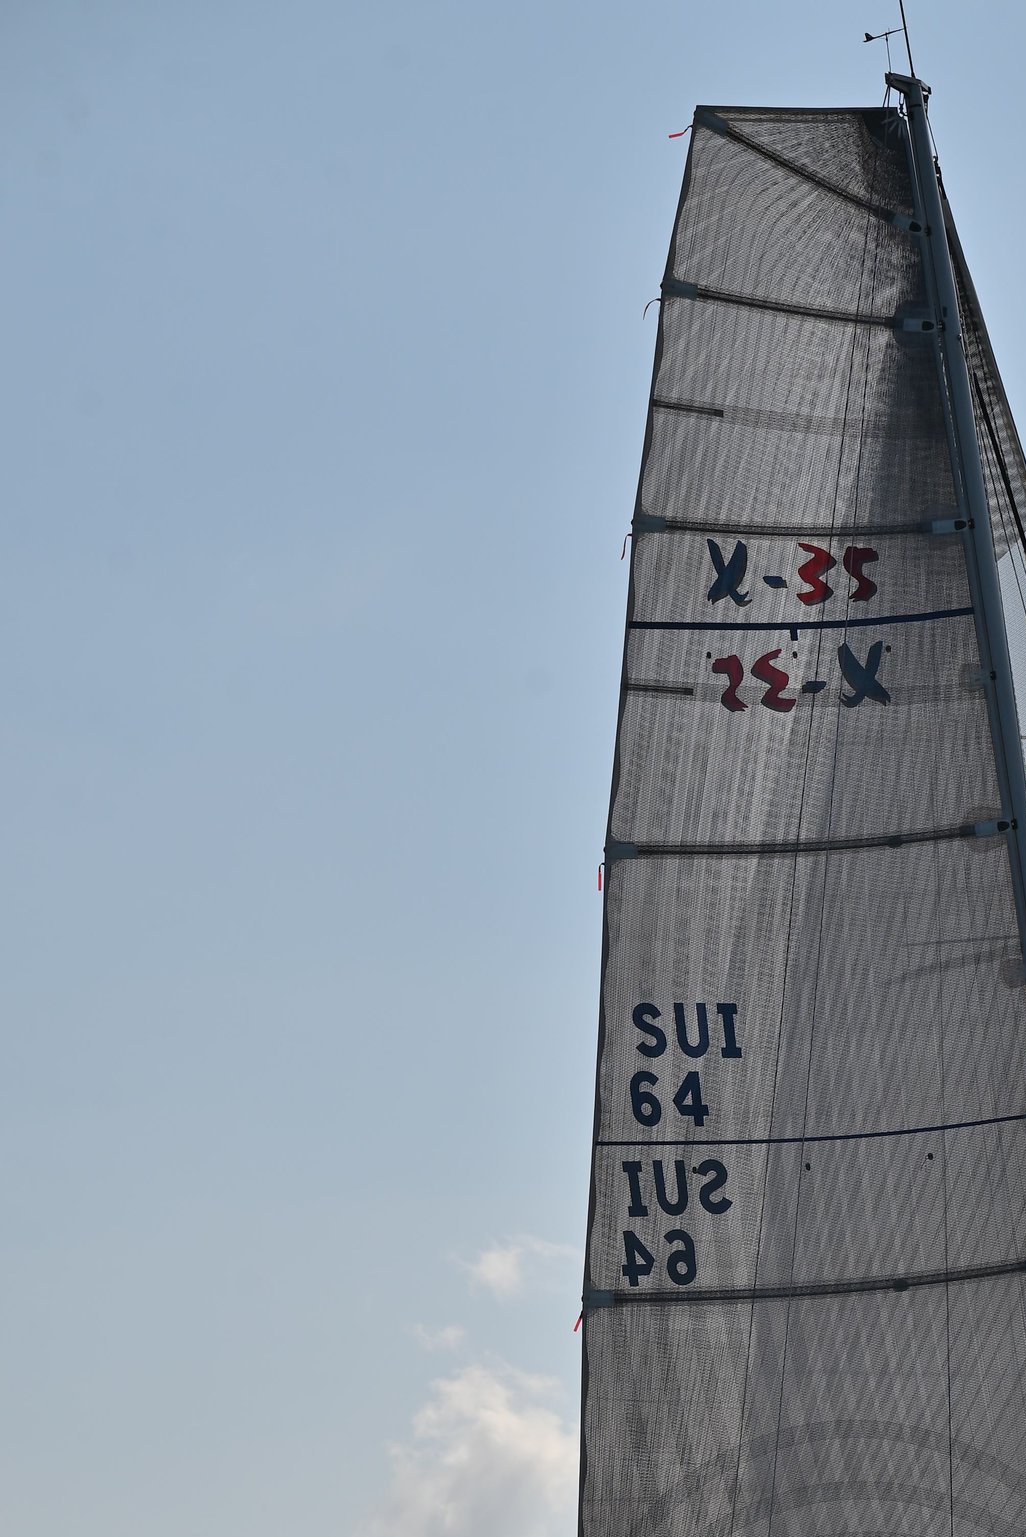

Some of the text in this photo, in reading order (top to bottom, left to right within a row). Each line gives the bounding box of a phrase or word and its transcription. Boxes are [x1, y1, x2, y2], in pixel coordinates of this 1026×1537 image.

[707, 538, 879, 606] X-35
[632, 1002, 742, 1058] SUI
[630, 1071, 709, 1127] 64
